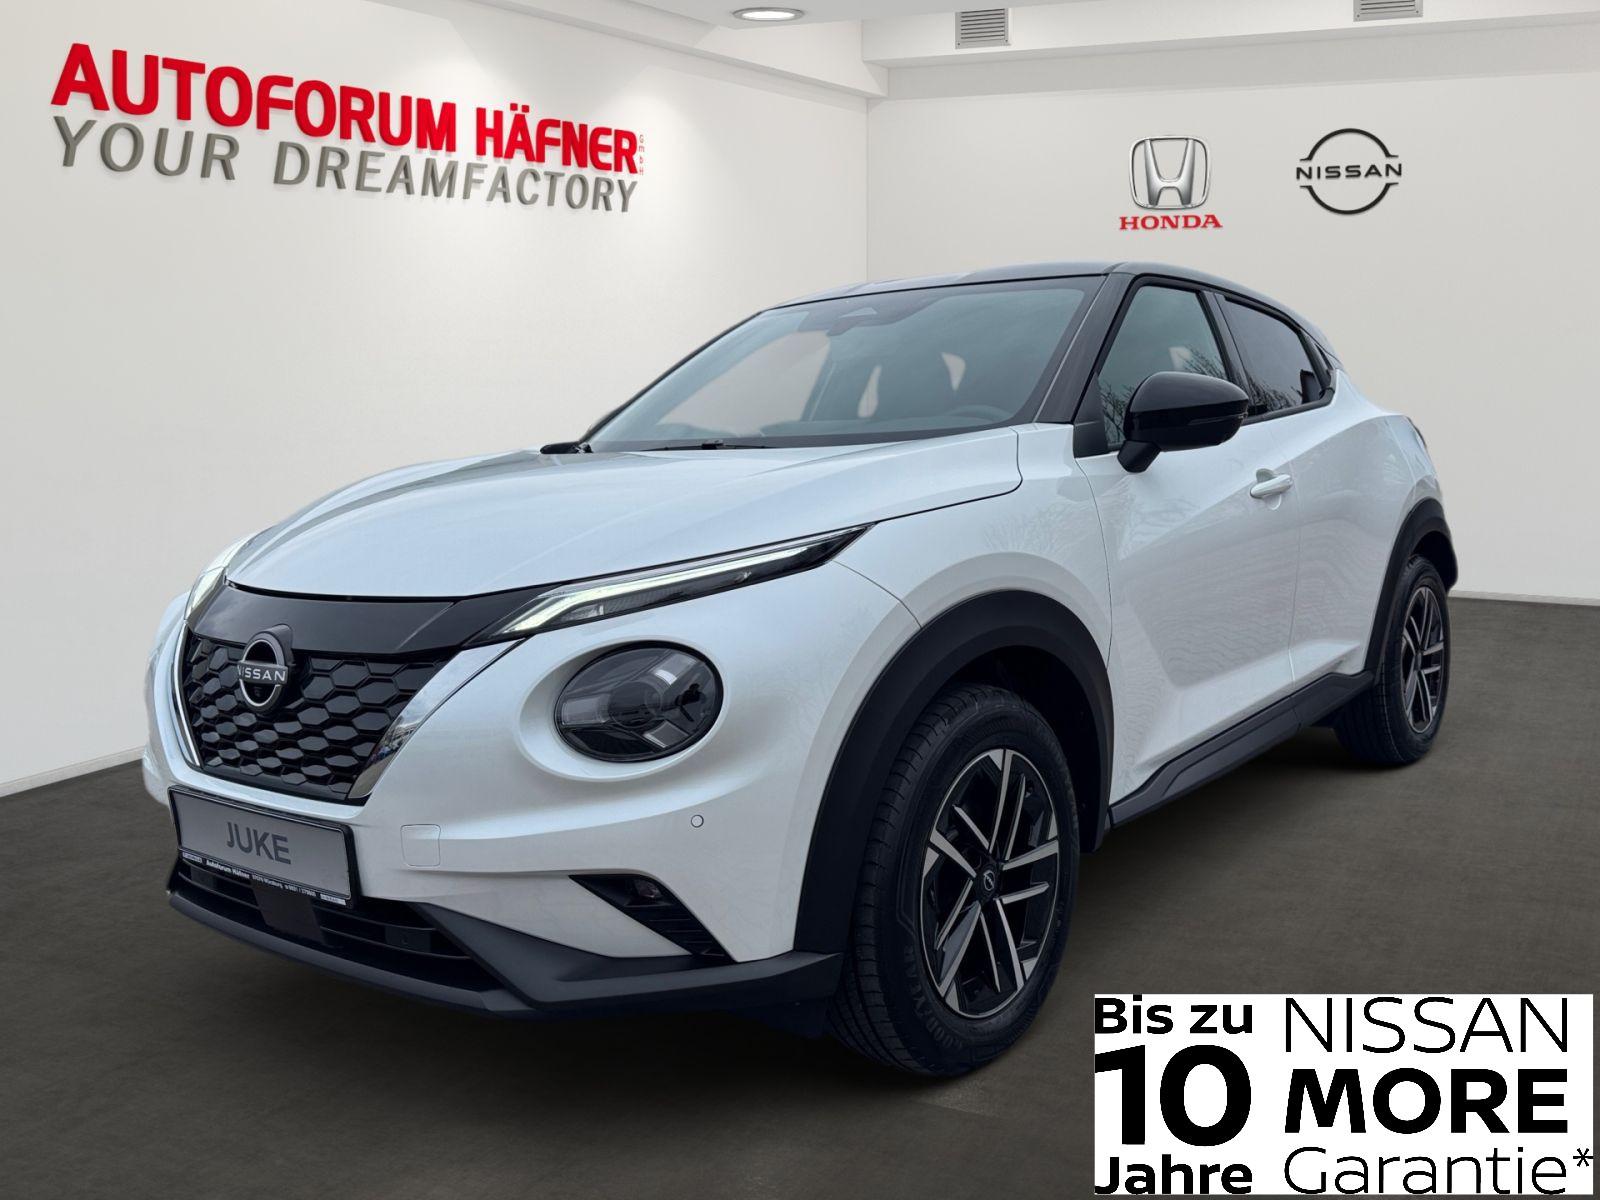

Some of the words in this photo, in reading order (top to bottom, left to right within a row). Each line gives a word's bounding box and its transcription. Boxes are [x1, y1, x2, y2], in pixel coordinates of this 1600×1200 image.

[50, 43, 457, 154] AUTOFORUM
[476, 103, 639, 175] HÄFNER
[52, 115, 240, 181] YOUR
[273, 140, 639, 213] DREAMFACTORY
[1296, 163, 1402, 181] NISSAN
[1118, 214, 1223, 231] HONDA
[226, 821, 292, 866] JUKE
